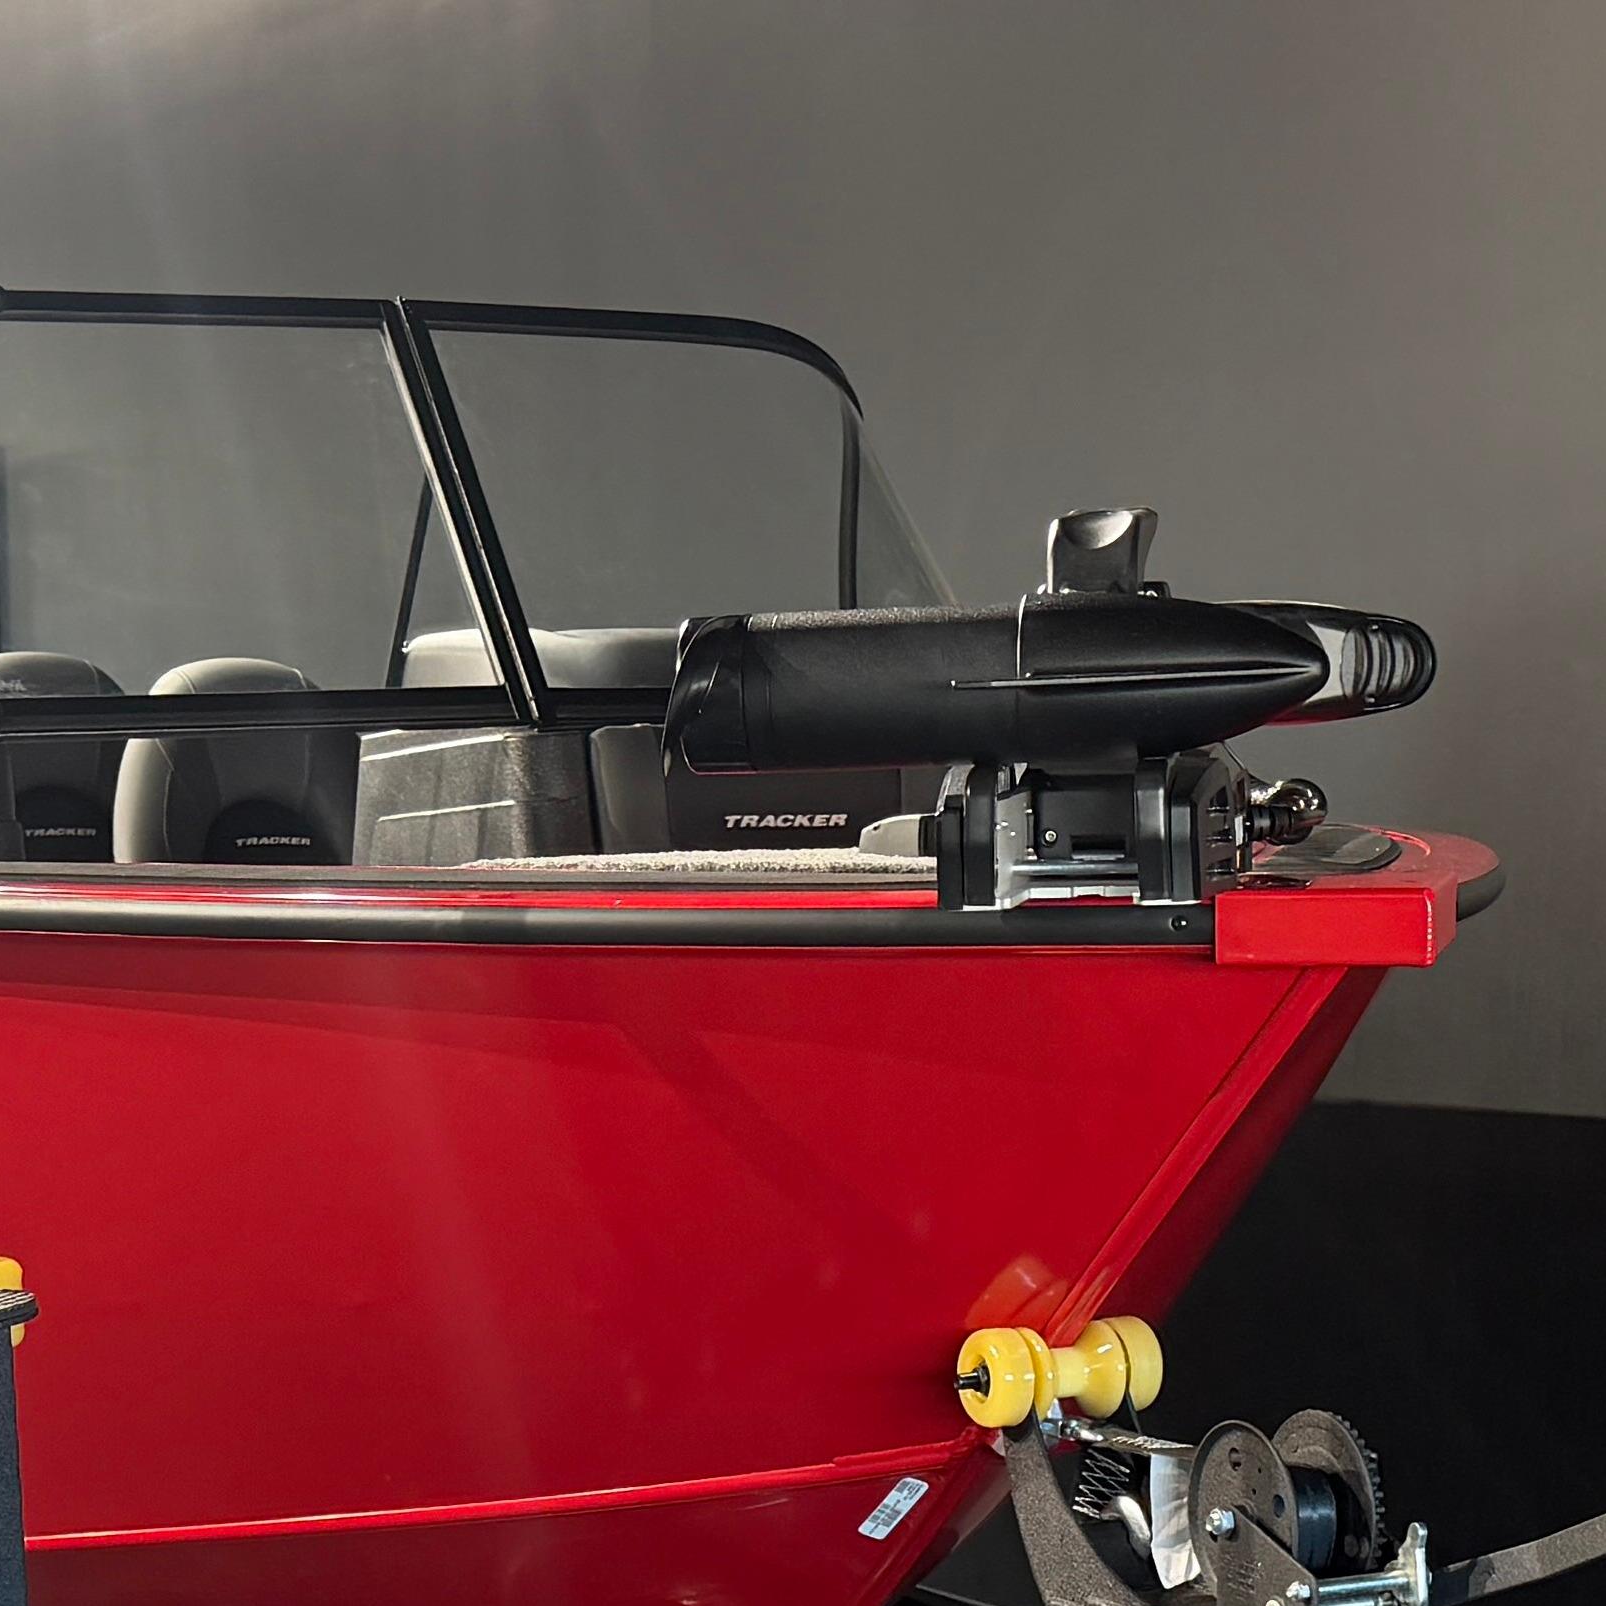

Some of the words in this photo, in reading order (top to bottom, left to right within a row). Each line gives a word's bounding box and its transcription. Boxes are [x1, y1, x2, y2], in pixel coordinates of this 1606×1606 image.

[724, 813, 848, 828] TRACKER
[24, 827, 96, 837] TRACKER
[236, 836, 311, 847] TRACKER
